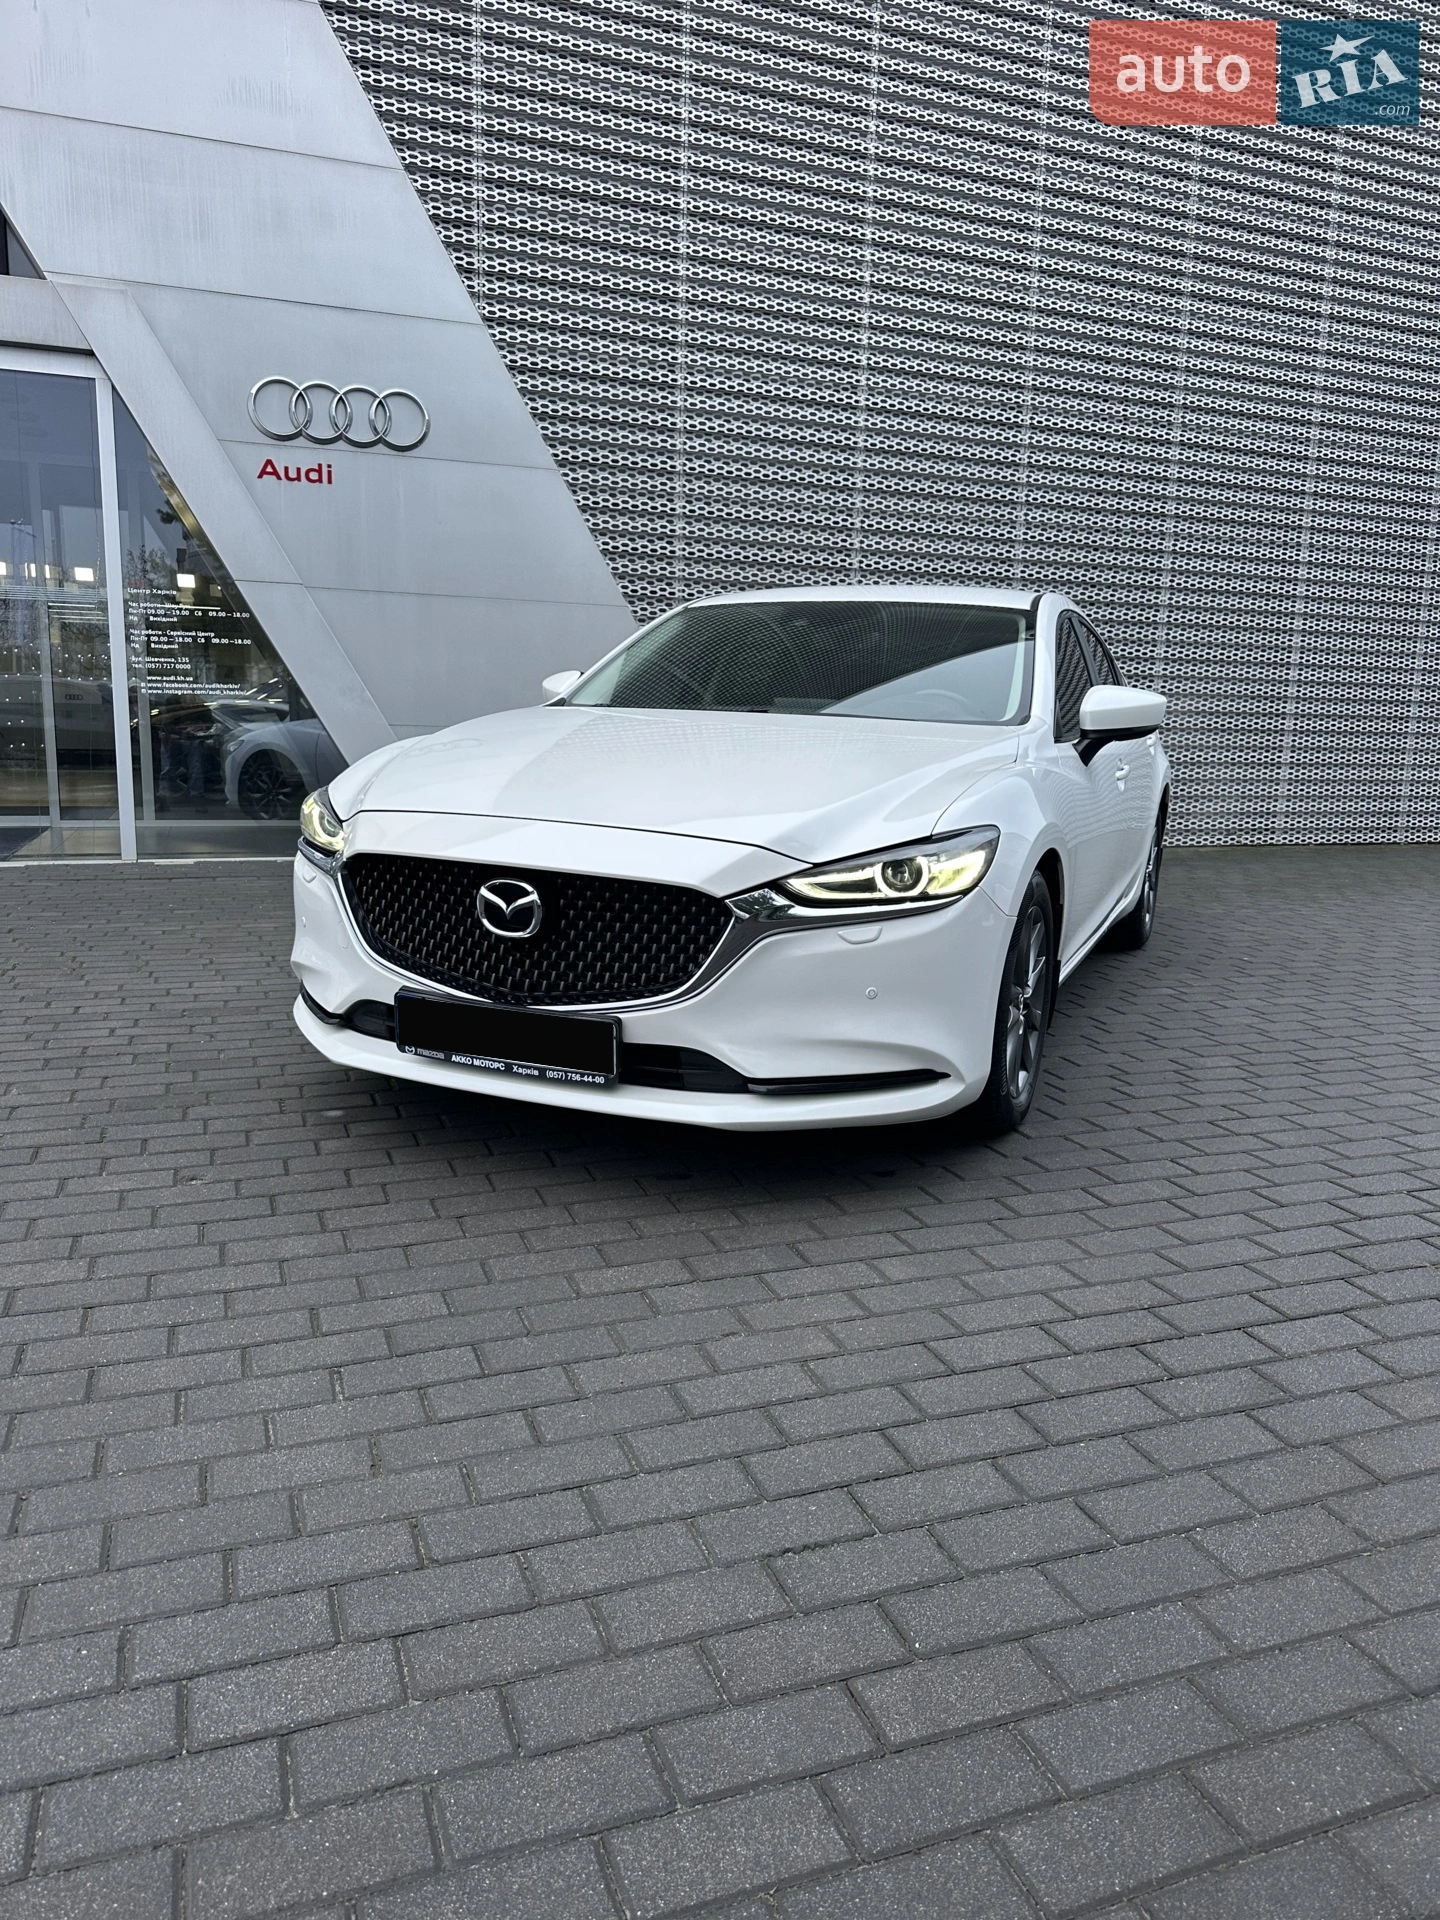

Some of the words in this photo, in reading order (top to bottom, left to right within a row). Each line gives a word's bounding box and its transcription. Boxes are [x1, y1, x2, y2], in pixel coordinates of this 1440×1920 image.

[257, 459, 333, 484] Audi
[417, 1048, 444, 1059] mazda
[451, 1054, 472, 1065] АККО
[473, 1058, 505, 1070] МОТОРС
[512, 1065, 539, 1076] Харків
[546, 1070, 565, 1080] (057)
[567, 1073, 605, 1084] 756-44-00
